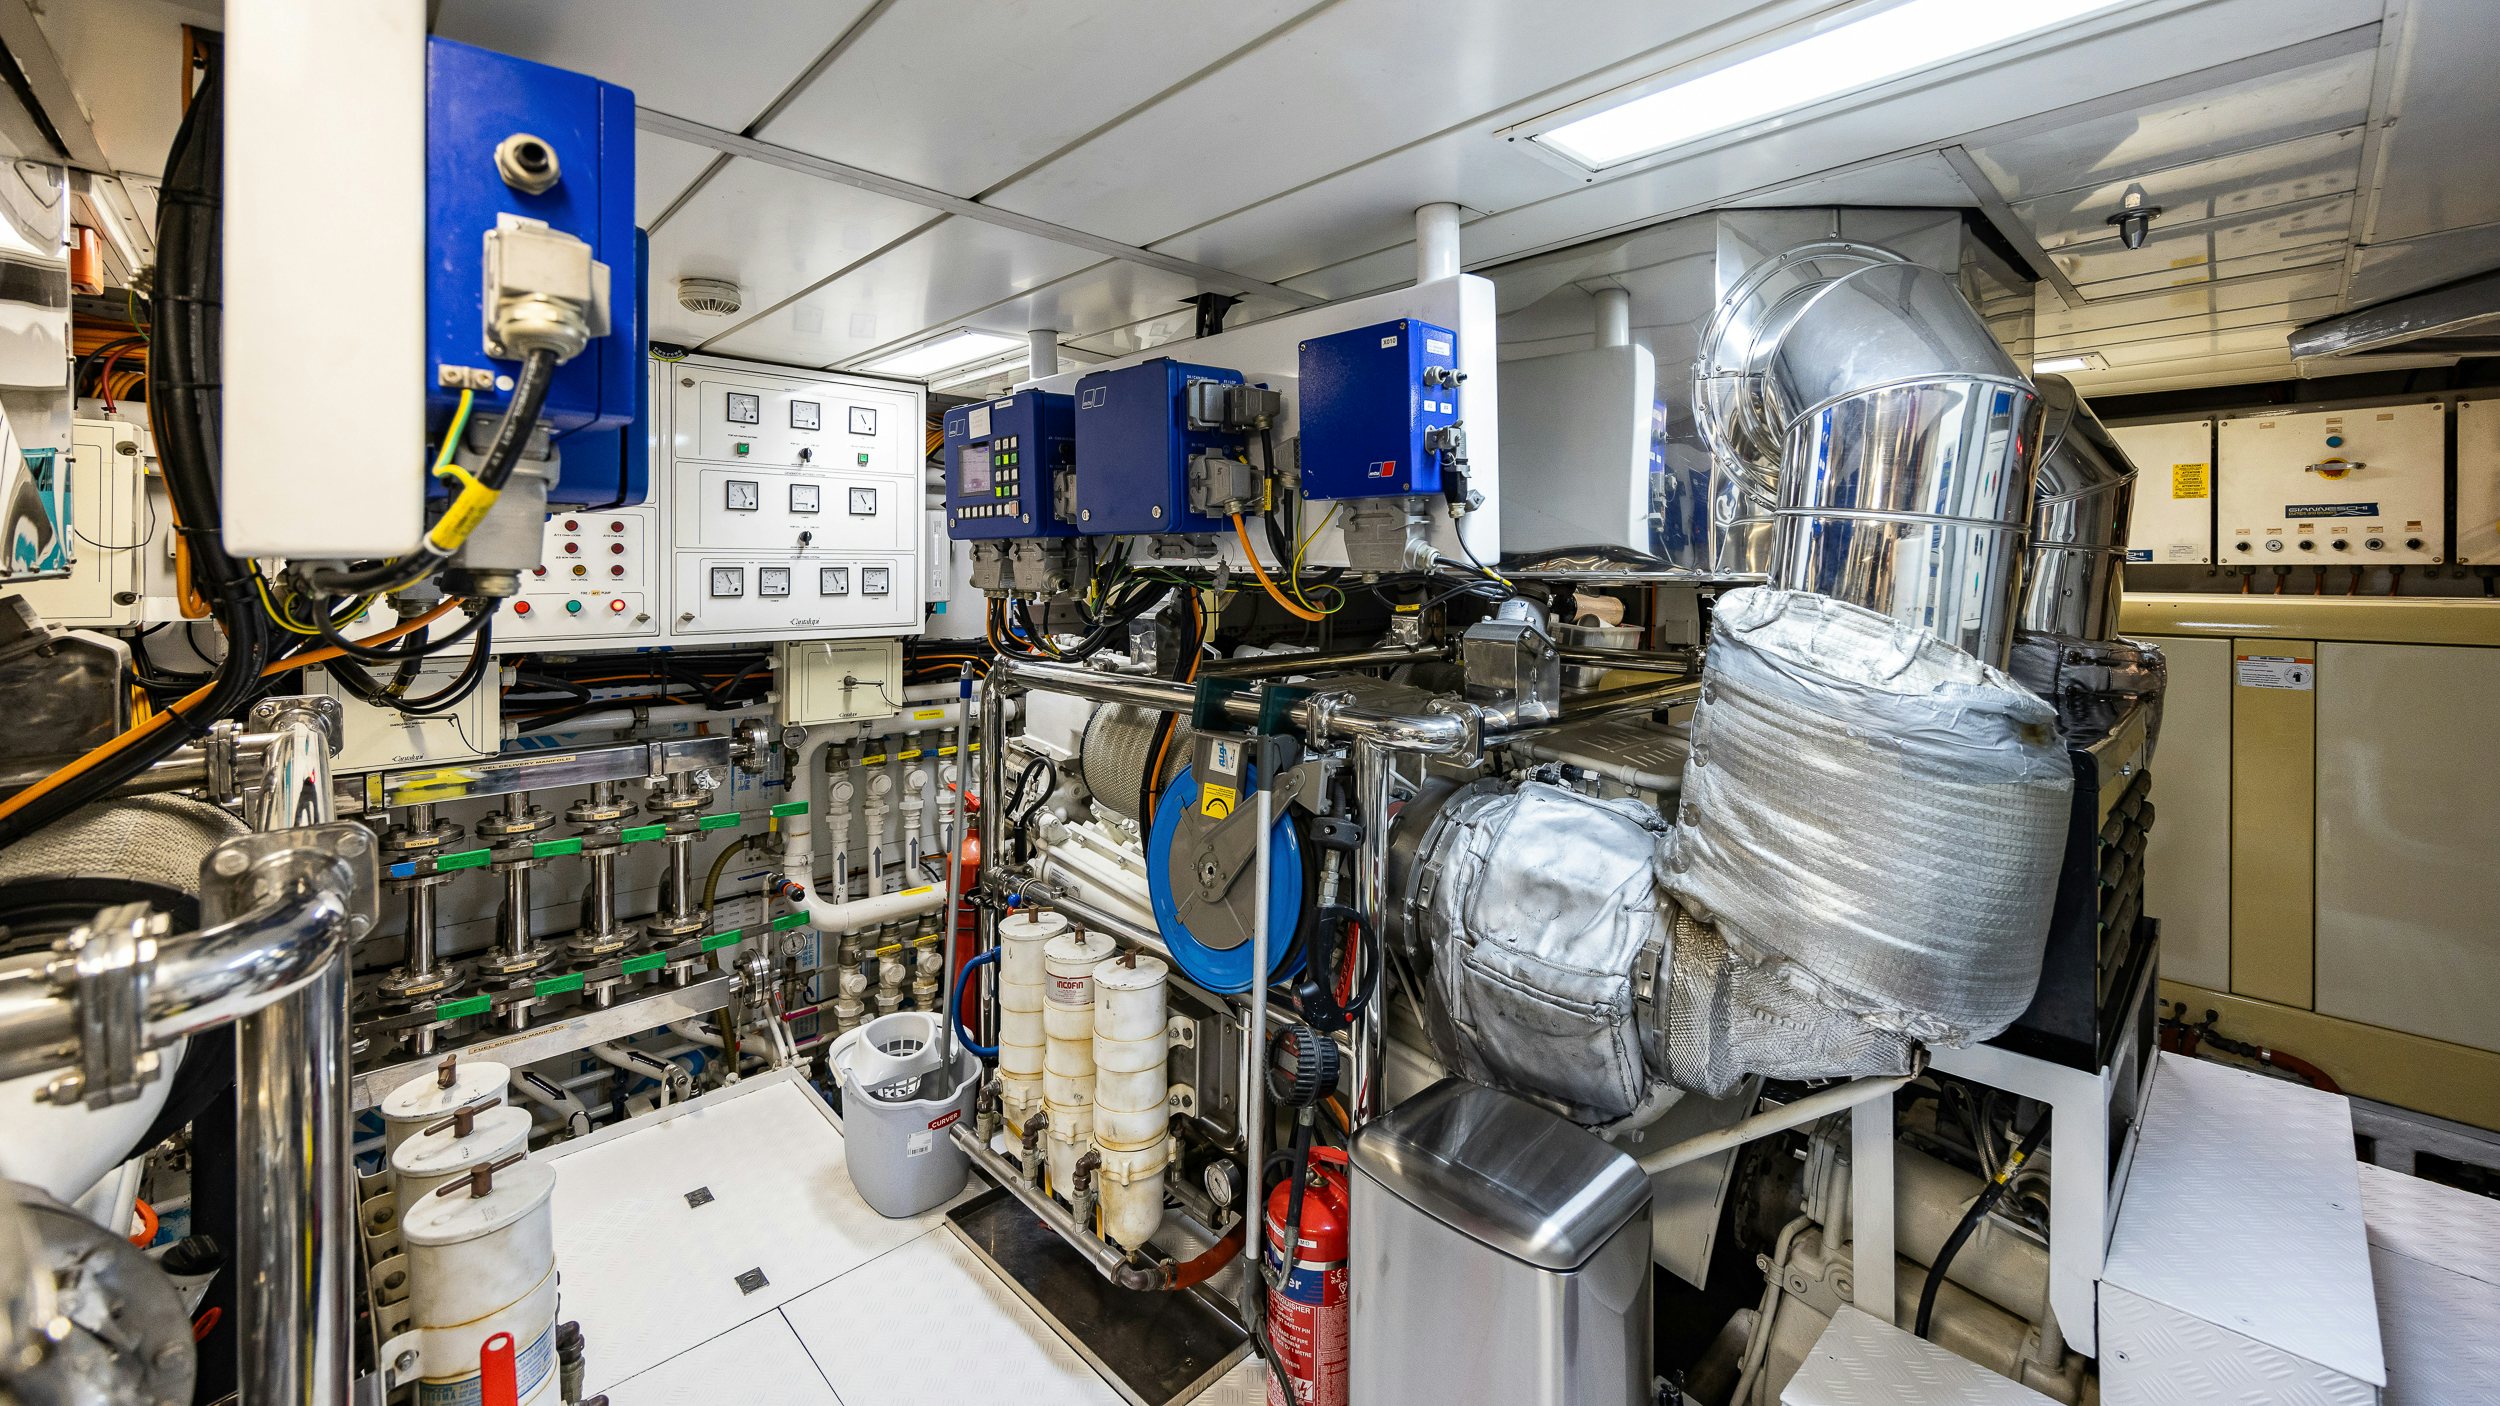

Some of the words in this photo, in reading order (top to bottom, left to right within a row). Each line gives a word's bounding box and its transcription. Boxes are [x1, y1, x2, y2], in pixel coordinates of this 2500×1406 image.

[494, 1036, 526, 1047] SUCTION
[529, 1025, 564, 1037] MANIFOLD
[932, 1113, 958, 1128] CURVER
[1284, 1320, 1301, 1333] SAFETY
[1294, 1348, 1312, 1358] METRE
